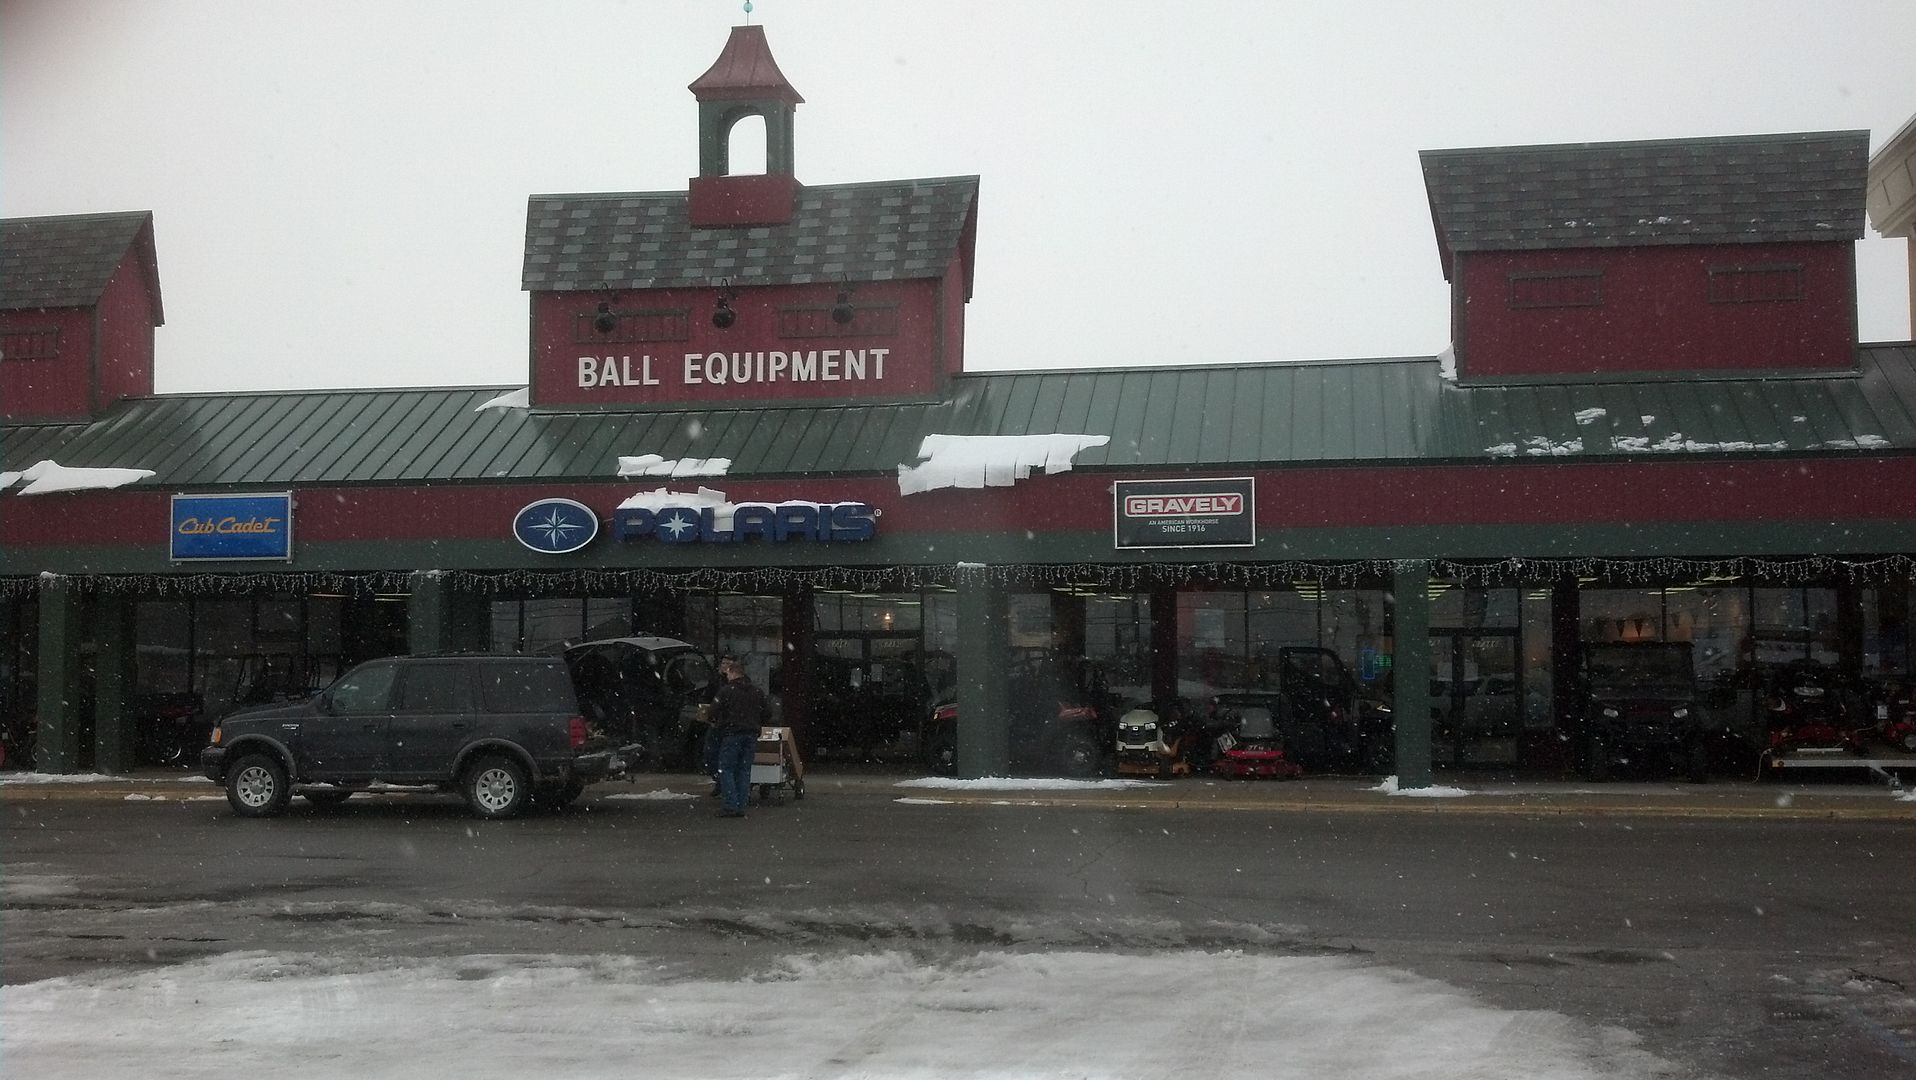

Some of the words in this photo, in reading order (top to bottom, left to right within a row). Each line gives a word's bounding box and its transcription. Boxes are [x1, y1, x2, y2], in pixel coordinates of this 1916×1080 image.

[577, 355, 660, 388] BALL
[684, 348, 890, 385] EQUIPMENT
[1130, 497, 1238, 513] GRAVELY
[179, 518, 215, 534] Cub
[216, 516, 280, 533] Cadet
[614, 504, 876, 542] POLARIS
[1162, 525, 1186, 533] SINCE
[1188, 524, 1206, 532] 1916
